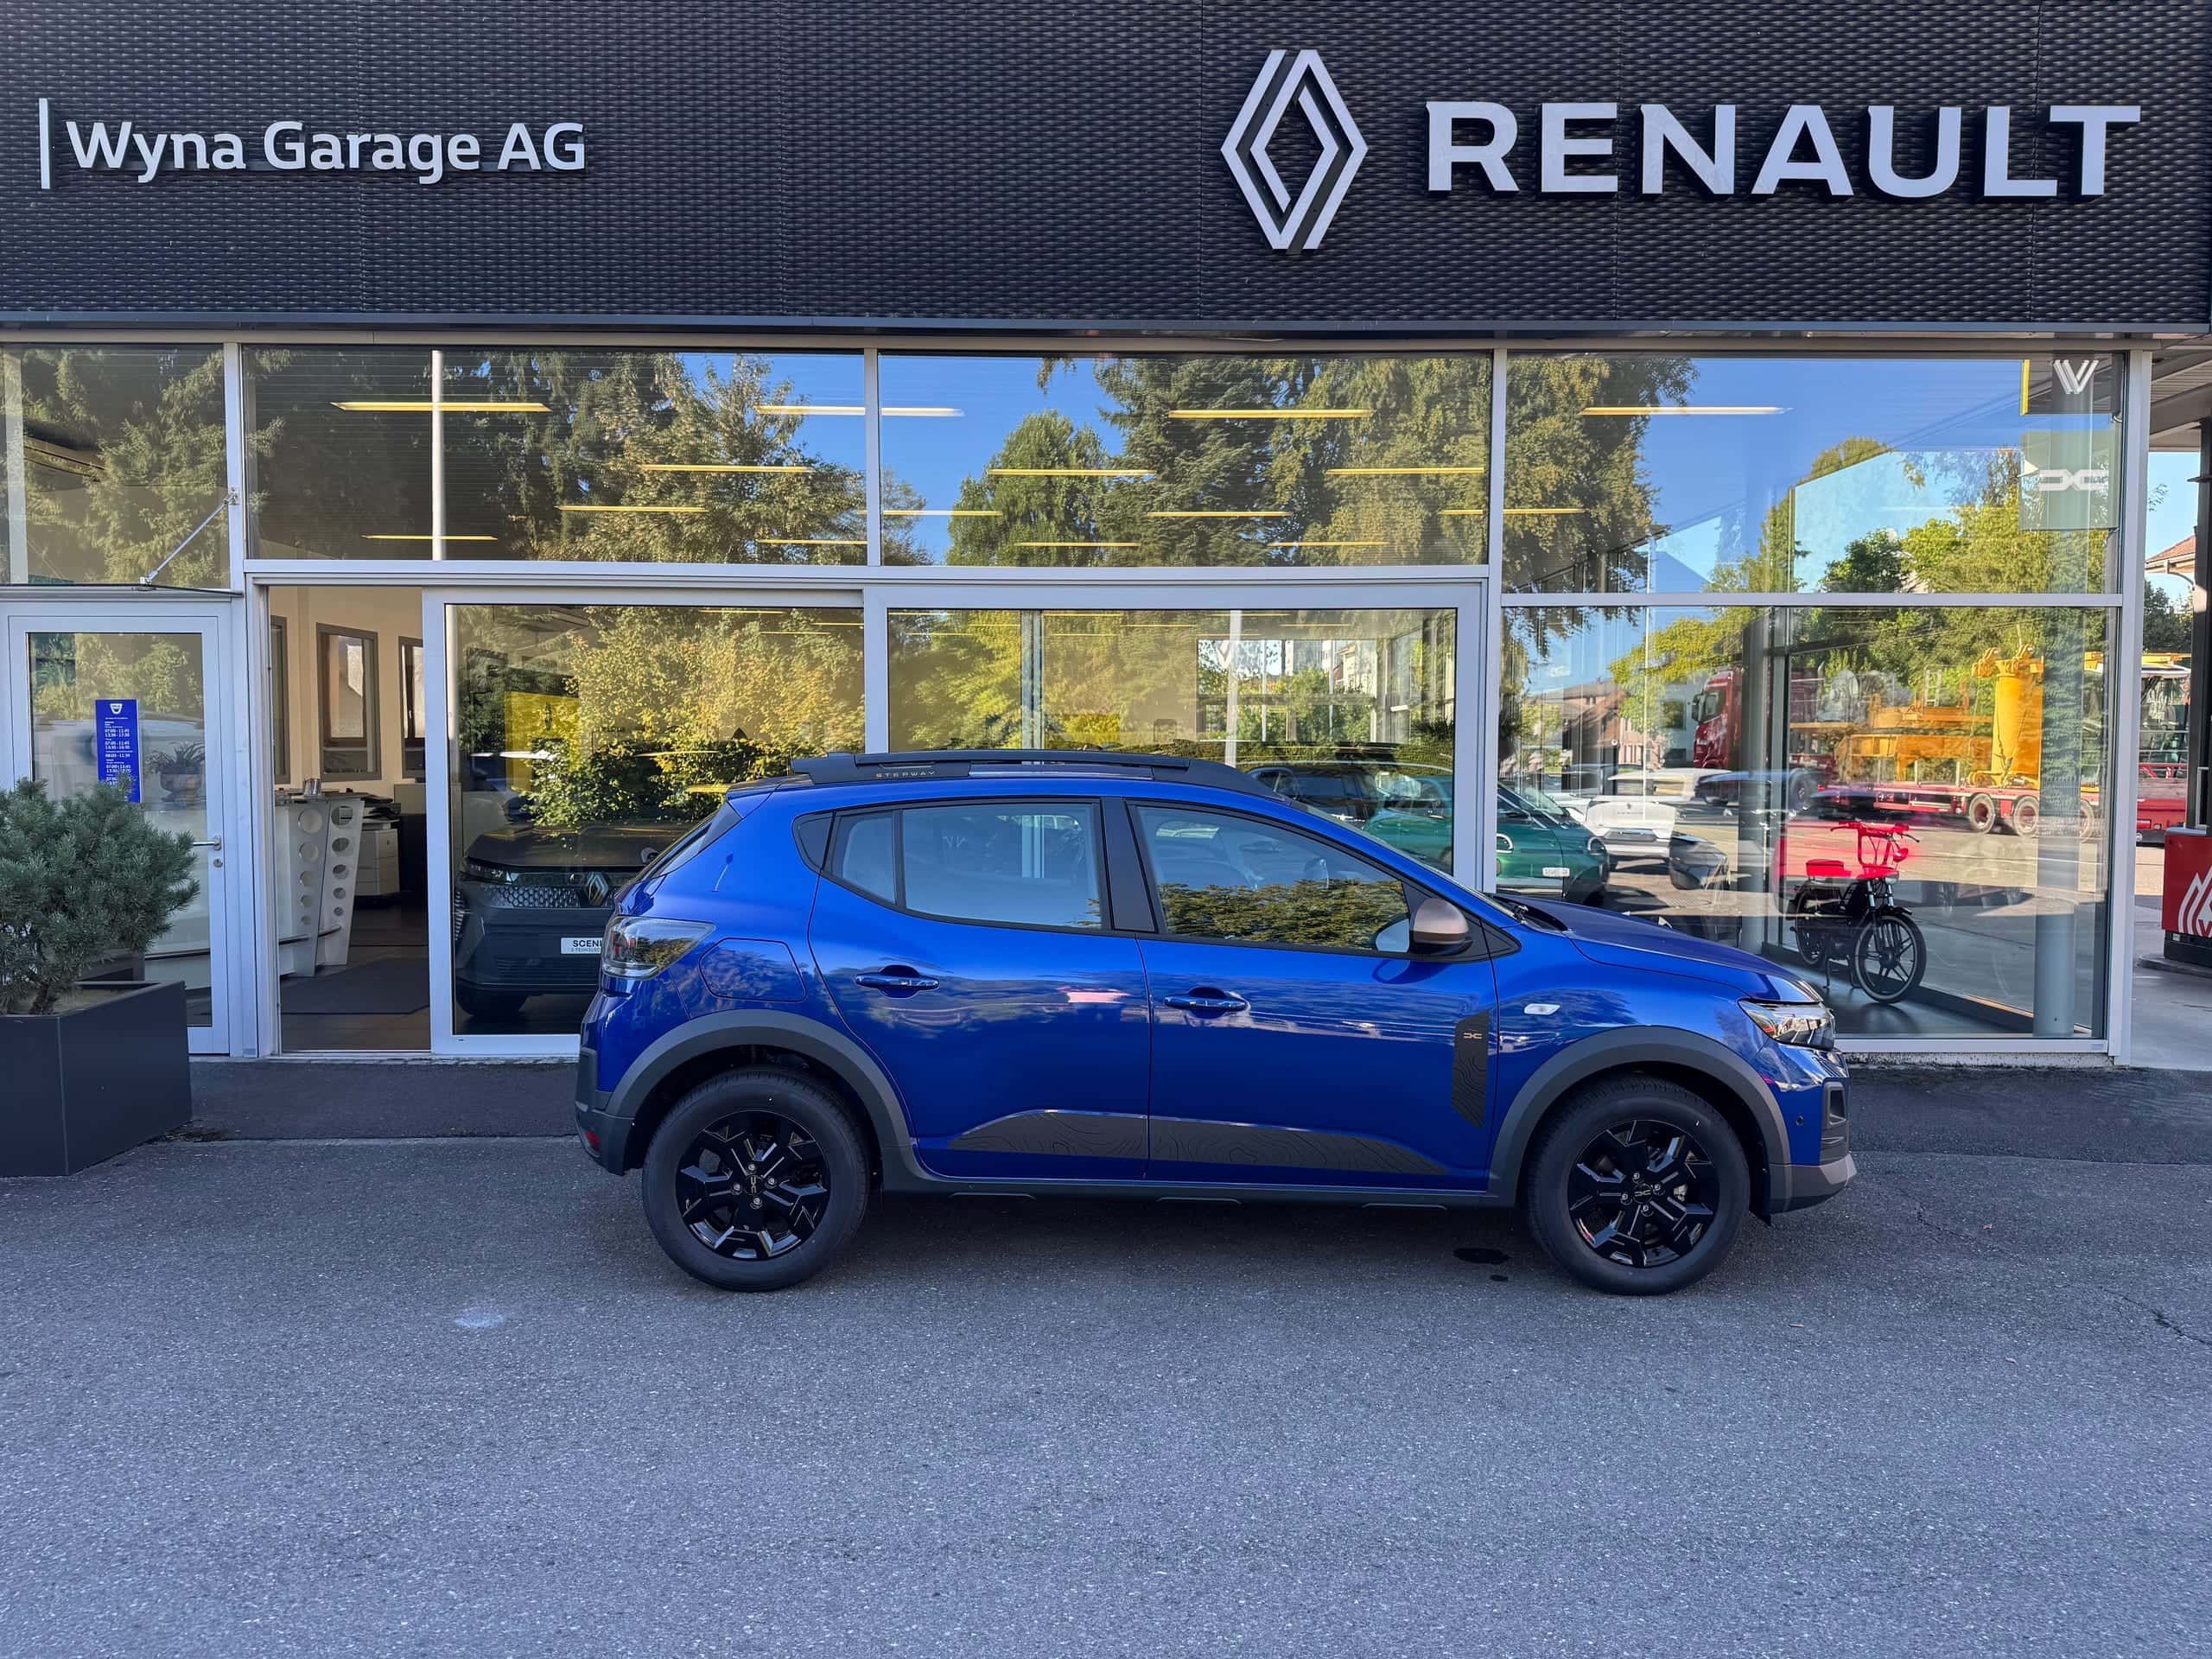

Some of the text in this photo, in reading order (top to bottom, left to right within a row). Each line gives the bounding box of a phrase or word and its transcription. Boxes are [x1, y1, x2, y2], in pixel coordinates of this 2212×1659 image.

[66, 121, 586, 184] Wyna Garage AG
[1425, 100, 2142, 199] RENAULT
